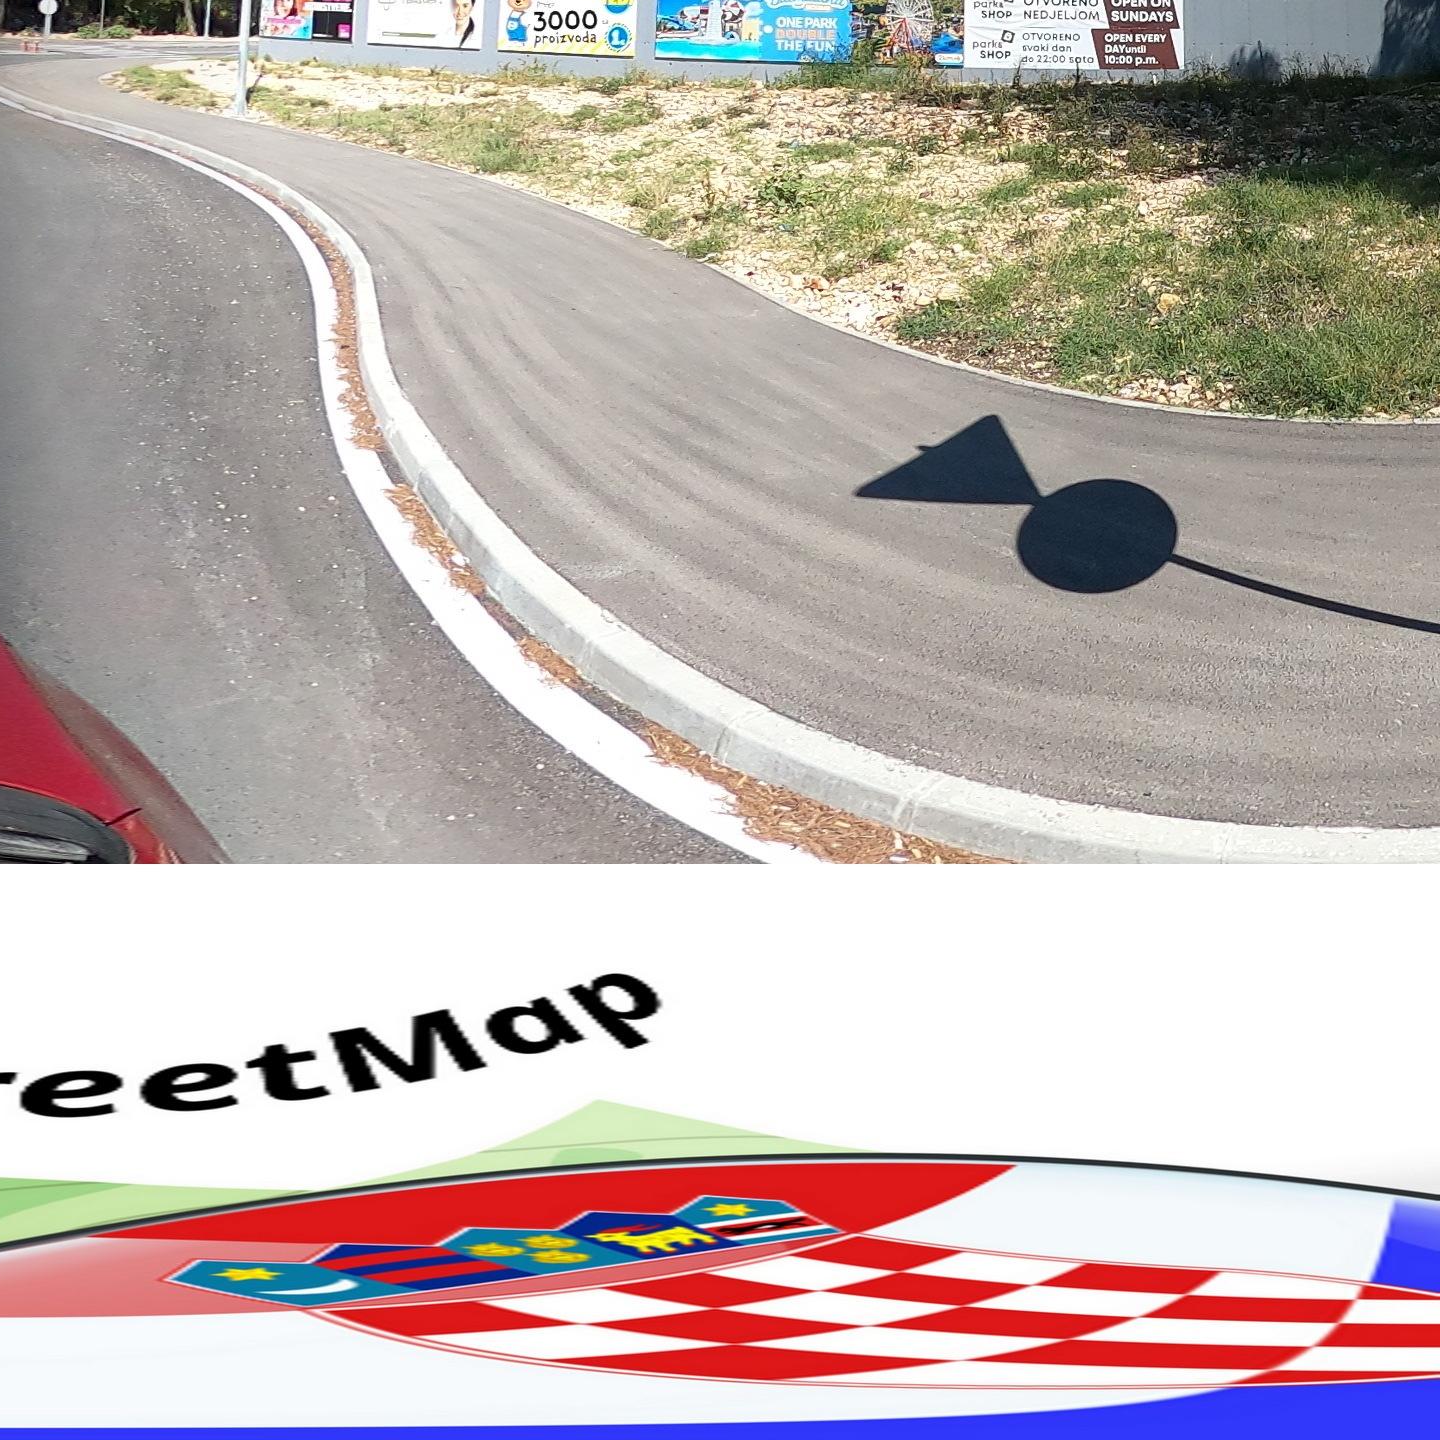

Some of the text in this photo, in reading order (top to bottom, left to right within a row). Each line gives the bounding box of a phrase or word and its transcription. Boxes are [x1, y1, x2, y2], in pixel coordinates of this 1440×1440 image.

[981, 10, 1013, 19] SHOP
[1023, 9, 1100, 21] NEDJELJOM
[1110, 10, 1174, 23] SUNDAYS
[533, 9, 598, 32] 3000
[775, 16, 838, 29] ONE PARK
[534, 31, 597, 48] proizvoda
[1022, 32, 1081, 42] OTVORENO
[1104, 33, 1167, 43] OPEN EVERY
[775, 40, 836, 52] THE FUN
[1022, 43, 1072, 53] svaki dan
[980, 50, 1011, 60] SHOP
[1021, 55, 1094, 64] do 22:00 sata
[1104, 55, 1159, 66] 10:00 p.m.
